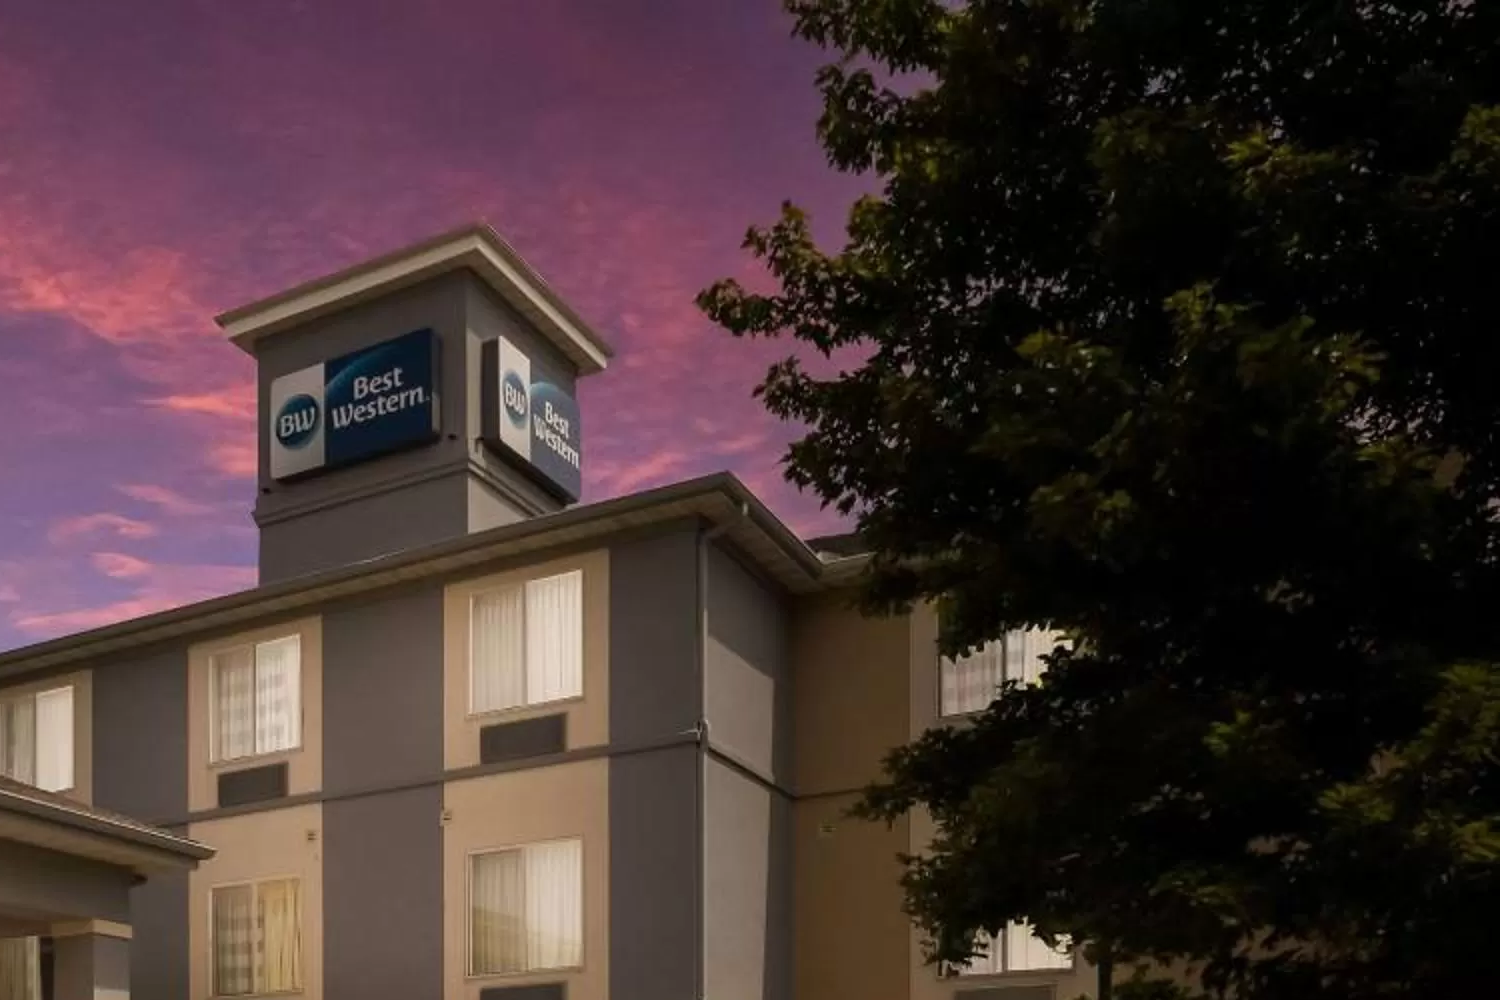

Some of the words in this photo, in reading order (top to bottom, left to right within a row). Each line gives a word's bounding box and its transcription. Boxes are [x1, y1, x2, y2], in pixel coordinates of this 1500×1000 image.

[353, 367, 403, 400] Best
[505, 382, 525, 415] BW
[280, 406, 316, 438] BW
[331, 386, 425, 430] Western
[545, 400, 569, 440] Best
[533, 413, 580, 469] Western
